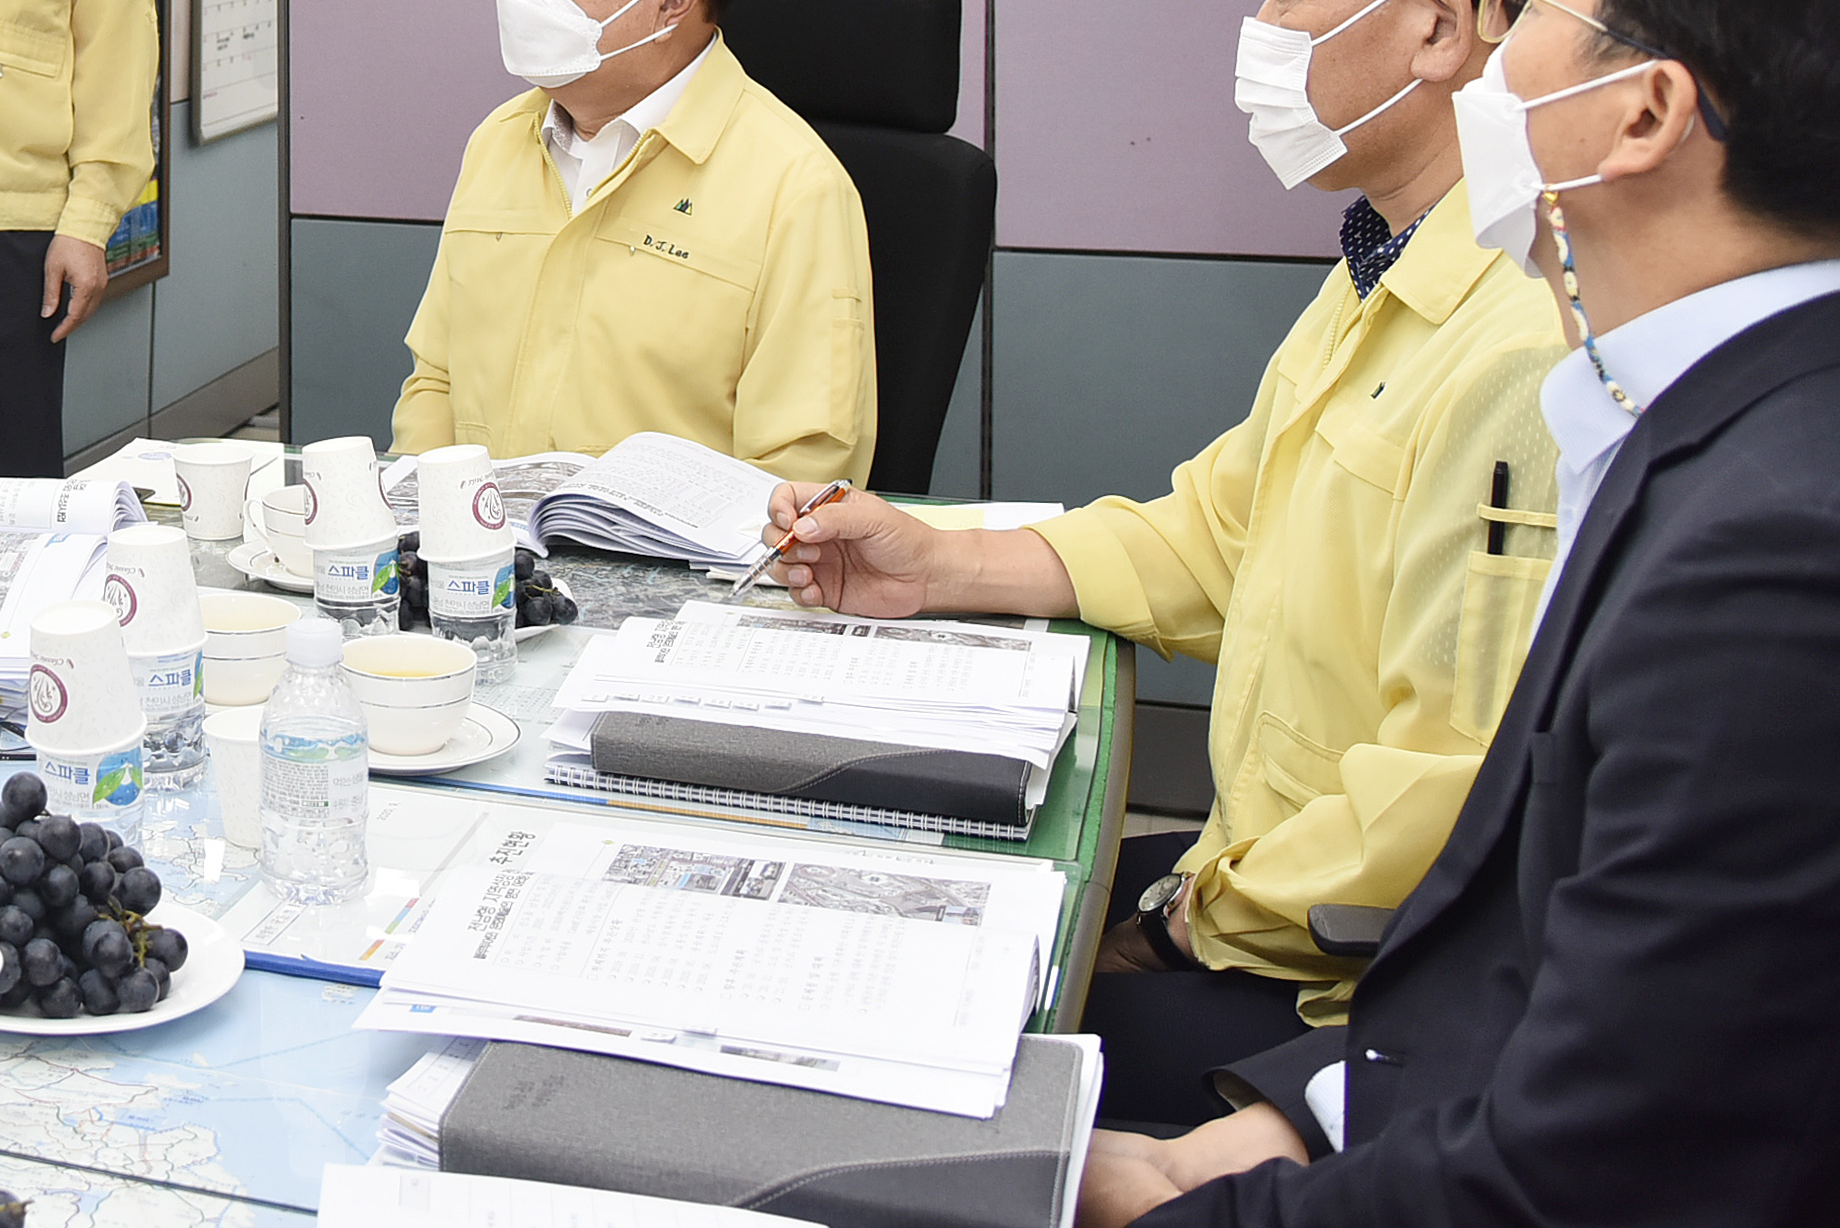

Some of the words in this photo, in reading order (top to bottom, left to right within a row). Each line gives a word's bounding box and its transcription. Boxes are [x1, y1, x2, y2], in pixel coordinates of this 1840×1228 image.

[643, 234, 654, 247] D.
[655, 240, 666, 252] J.
[57, 494, 69, 522] 조성사업
[328, 565, 369, 580] 스파클
[447, 580, 491, 595] 스파클
[148, 669, 191, 686] 스파클
[44, 760, 90, 785] 스파클
[488, 829, 536, 864] 추진현황
[467, 905, 496, 932] 전남형
